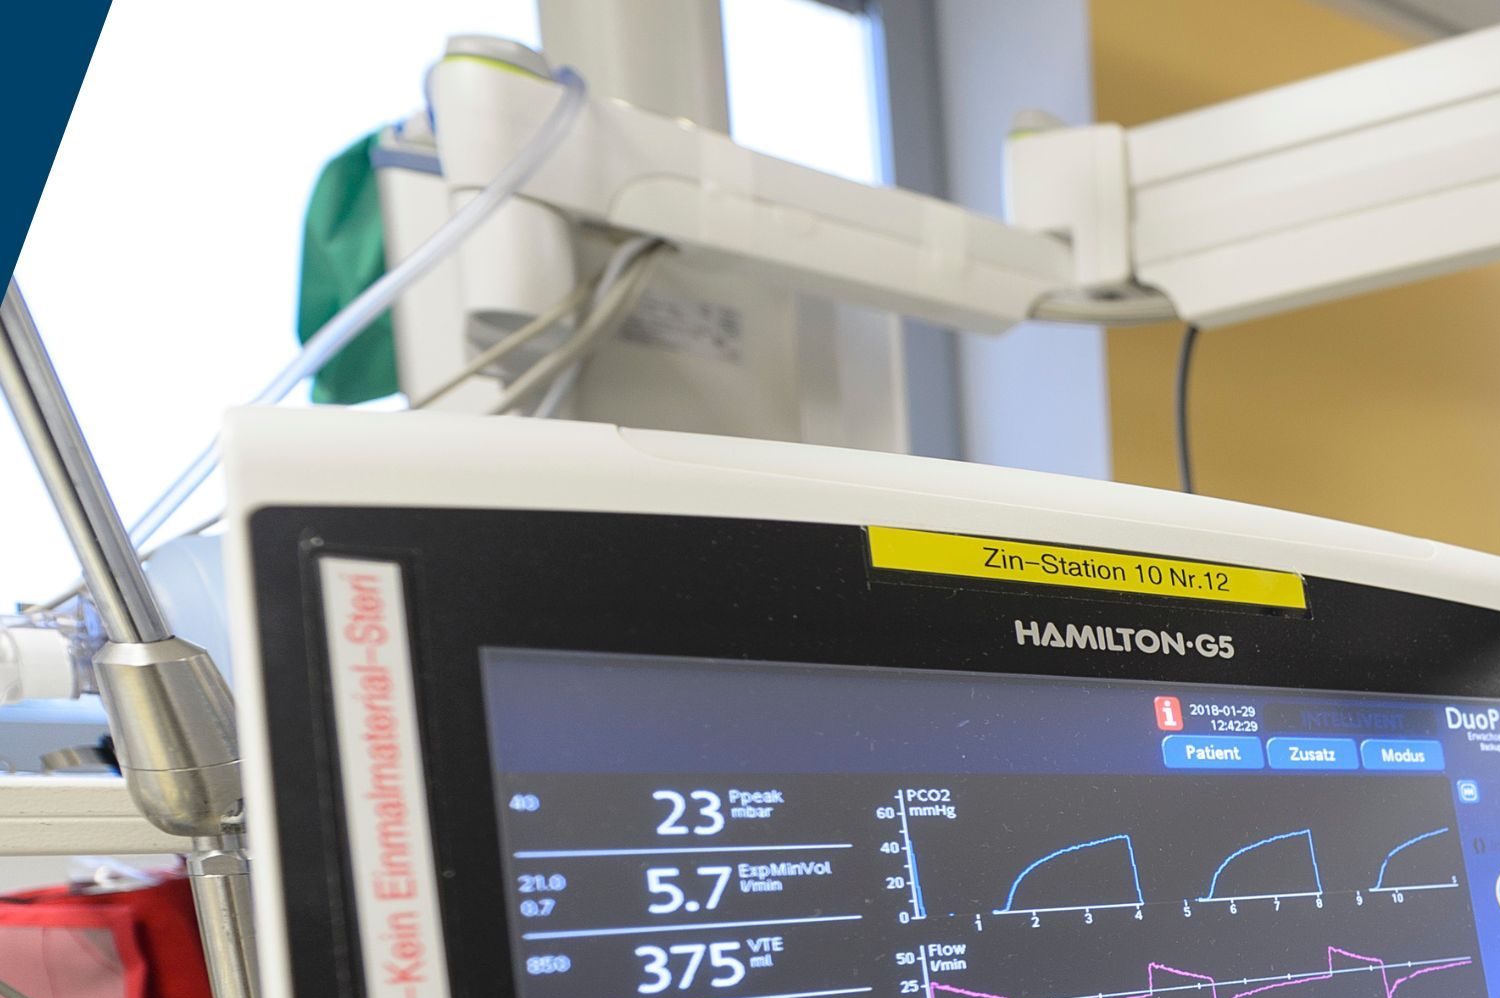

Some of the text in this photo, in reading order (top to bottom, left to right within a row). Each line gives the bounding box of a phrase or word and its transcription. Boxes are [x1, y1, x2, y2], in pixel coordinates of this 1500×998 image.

[1135, 564, 1163, 585] 10
[1170, 569, 1231, 592] Nr.12
[1189, 704, 1256, 717] 2018-01-29
[1211, 720, 1258, 732] 12:42:29
[1186, 744, 1242, 760] Patient
[1289, 747, 1337, 762] Zusatz
[1381, 749, 1425, 763] Modus
[728, 789, 784, 806] Ppeak
[906, 788, 951, 802] PCO2
[653, 790, 726, 836] 23
[731, 805, 773, 819] mbar
[876, 807, 895, 819] 60
[908, 804, 956, 819] mmHg
[880, 842, 900, 853] 40
[738, 861, 832, 880] ExpMinVol
[517, 874, 567, 892] 21.0
[646, 866, 732, 914] 5.7
[740, 879, 783, 892] l/min
[885, 877, 904, 889] 20
[519, 899, 556, 917] 0.7
[975, 919, 983, 931] 1
[1031, 916, 1041, 928] 2
[1084, 913, 1094, 924] 3
[1134, 909, 1143, 920] 4
[1183, 906, 1192, 917] 5
[1230, 903, 1237, 914] 6
[1274, 901, 1281, 911] 7
[1316, 897, 1323, 908] 8
[1356, 895, 1363, 905] 9
[1393, 892, 1404, 904] 10
[899, 912, 910, 924] 0
[746, 937, 784, 953] VTE
[927, 943, 966, 956] Flow
[750, 954, 773, 968] ml
[895, 953, 915, 965] 50
[930, 958, 967, 972] l/min
[634, 942, 745, 995] 375
[900, 980, 919, 992] 25
